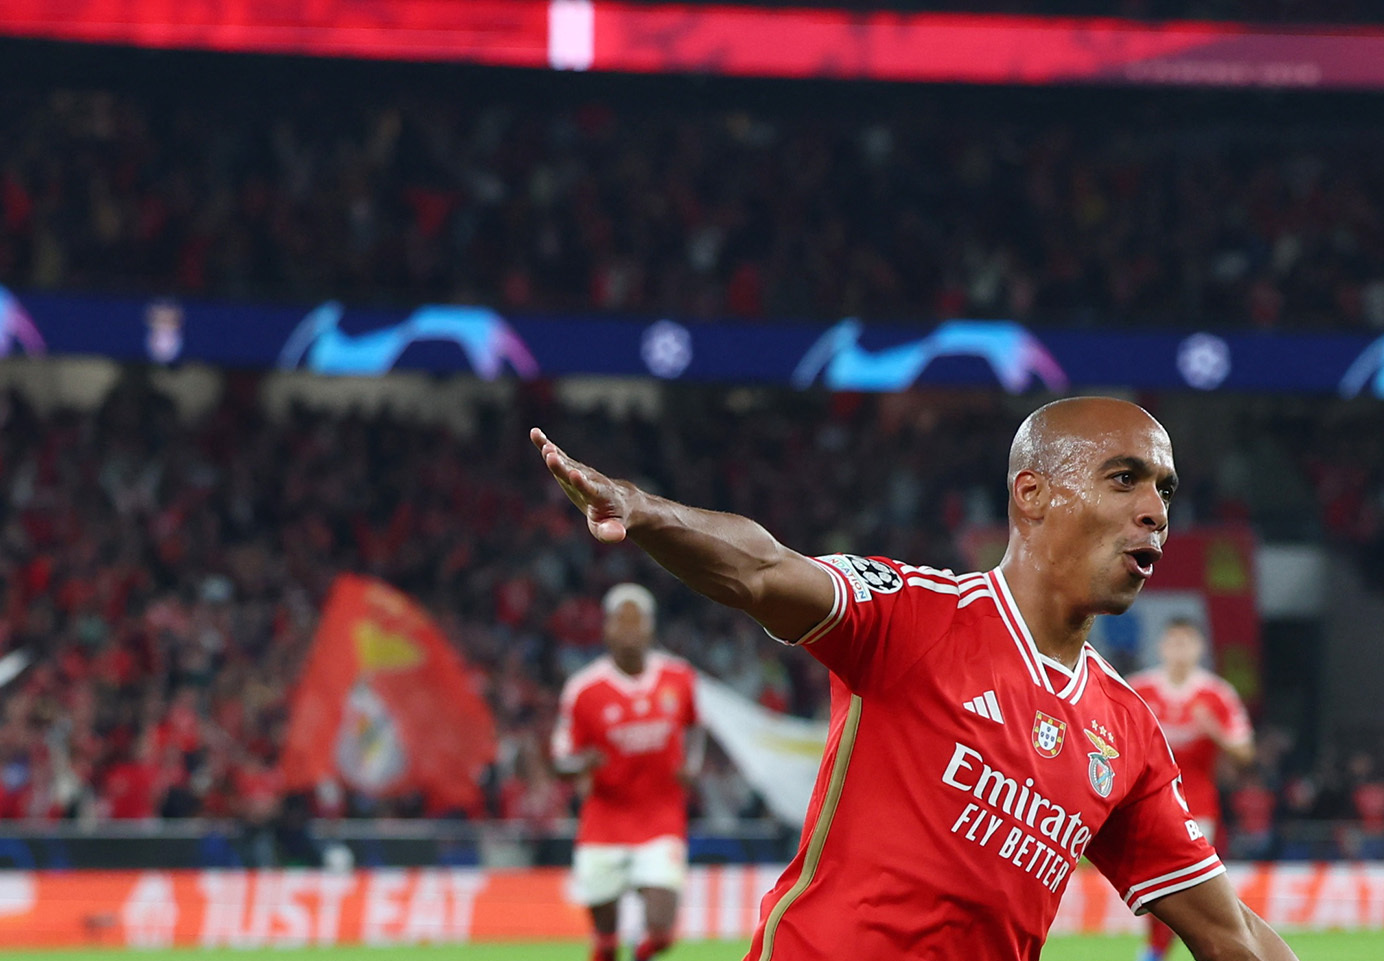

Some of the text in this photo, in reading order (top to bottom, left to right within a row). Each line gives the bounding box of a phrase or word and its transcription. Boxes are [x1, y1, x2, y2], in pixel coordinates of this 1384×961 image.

[951, 802, 1070, 894] FLY BETTER
[197, 867, 487, 949] JUST EAT
